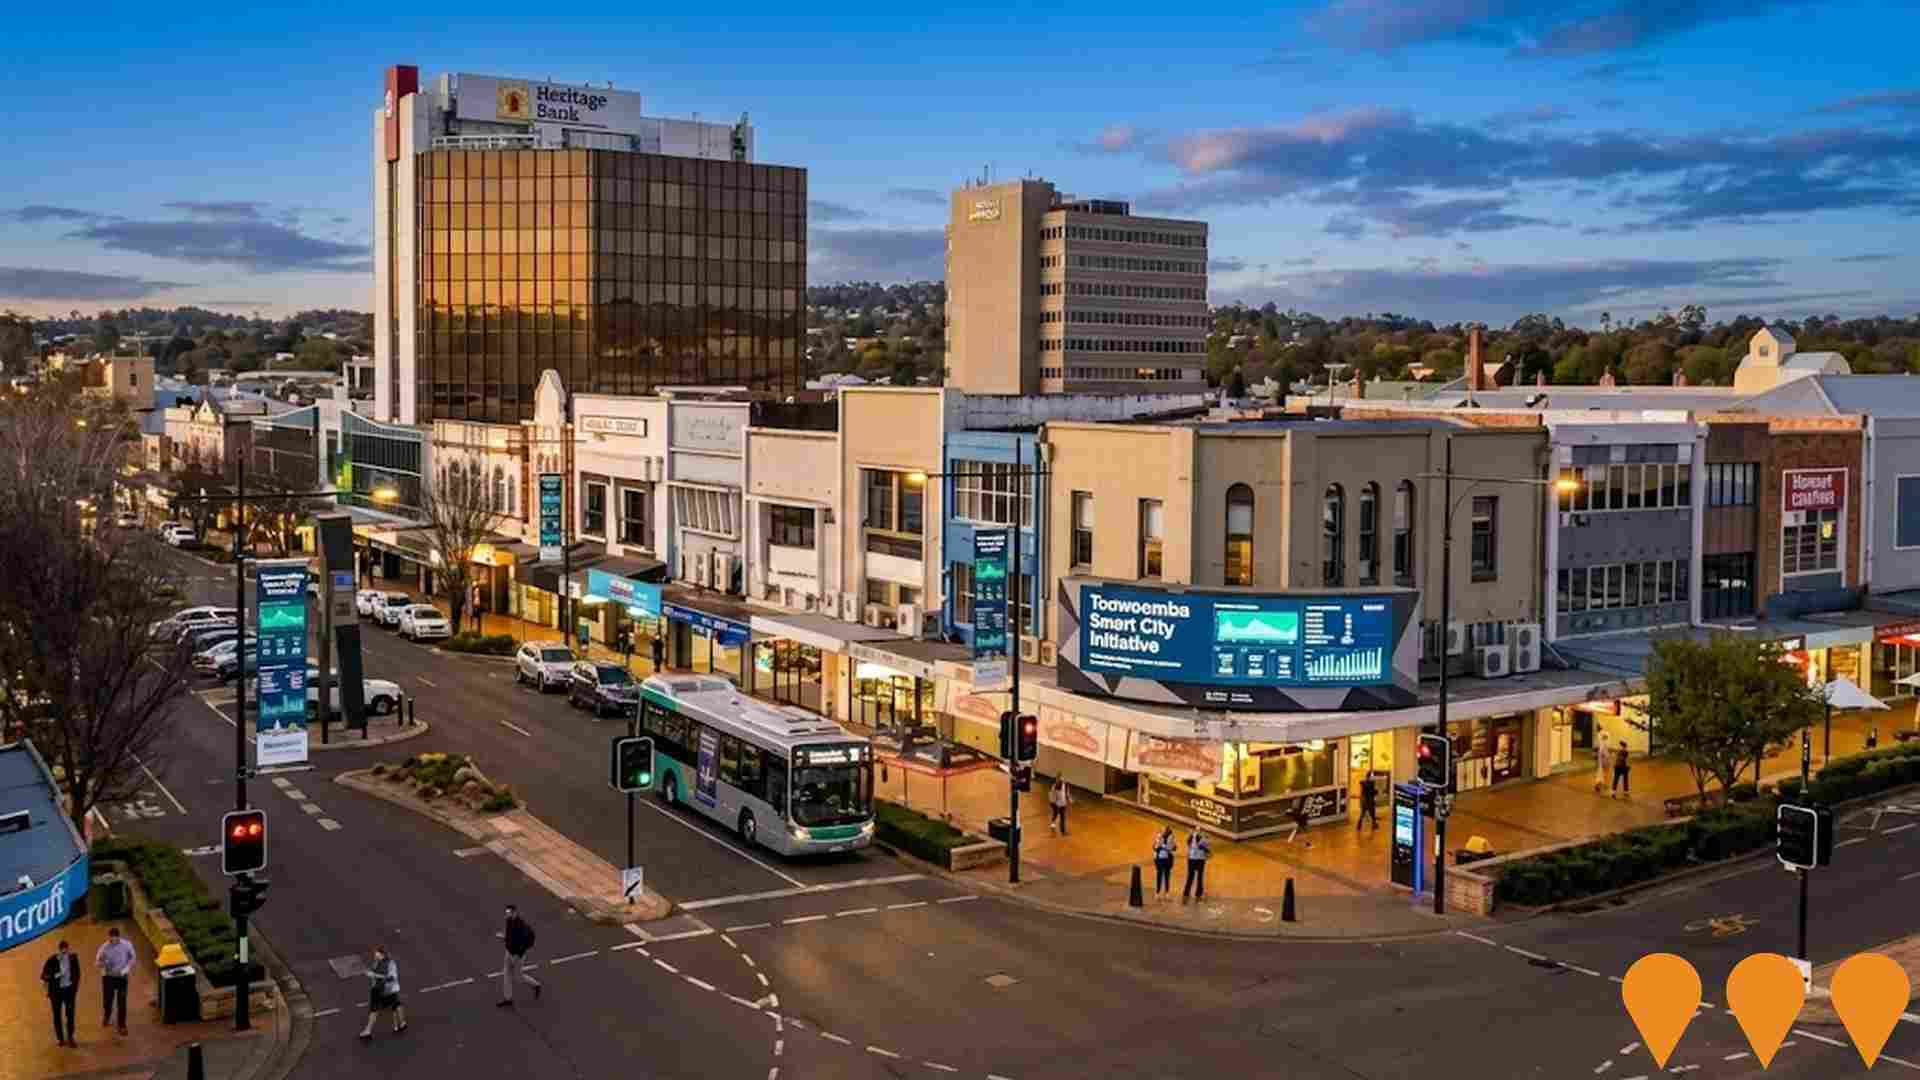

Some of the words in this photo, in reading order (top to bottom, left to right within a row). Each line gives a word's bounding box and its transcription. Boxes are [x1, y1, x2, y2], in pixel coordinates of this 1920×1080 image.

[536, 86, 608, 111] Heritage
[536, 103, 580, 121] Bank
[1089, 612, 1137, 633] Smart
[1140, 617, 1176, 640] City
[1089, 629, 1160, 654] Initiative
